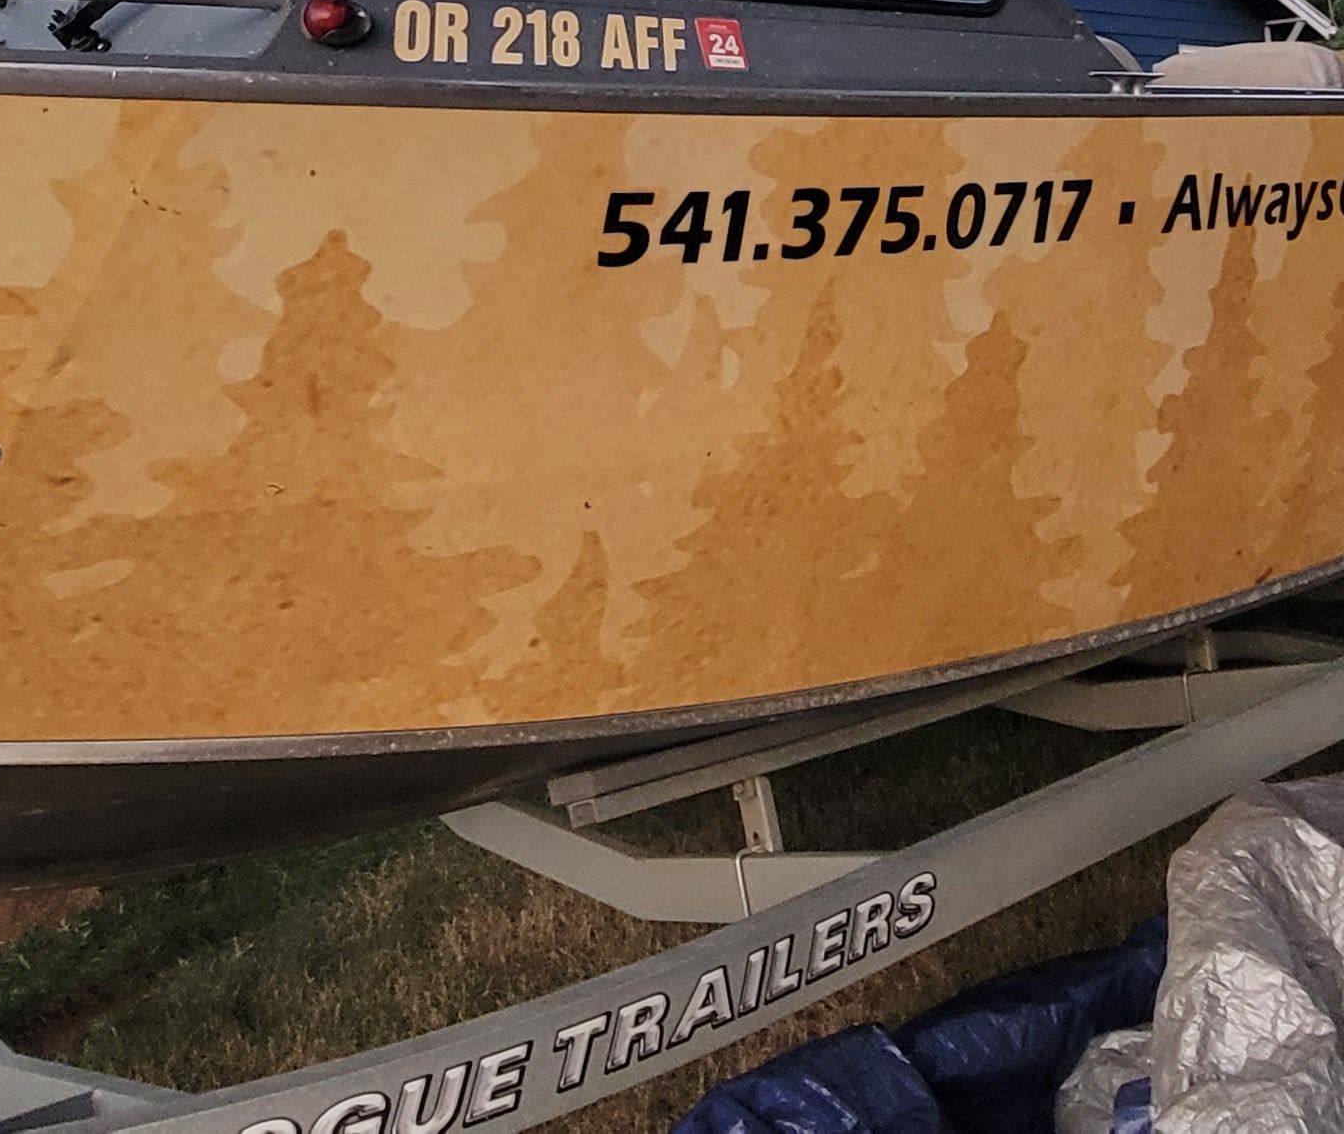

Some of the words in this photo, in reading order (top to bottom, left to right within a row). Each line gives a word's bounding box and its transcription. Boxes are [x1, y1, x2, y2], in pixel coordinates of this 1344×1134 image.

[491, 6, 580, 68] 218
[601, 13, 686, 71] AFF
[708, 33, 740, 55] 24
[597, 179, 1093, 268] 541.375.0717
[553, 871, 939, 1093] TRAILERS
